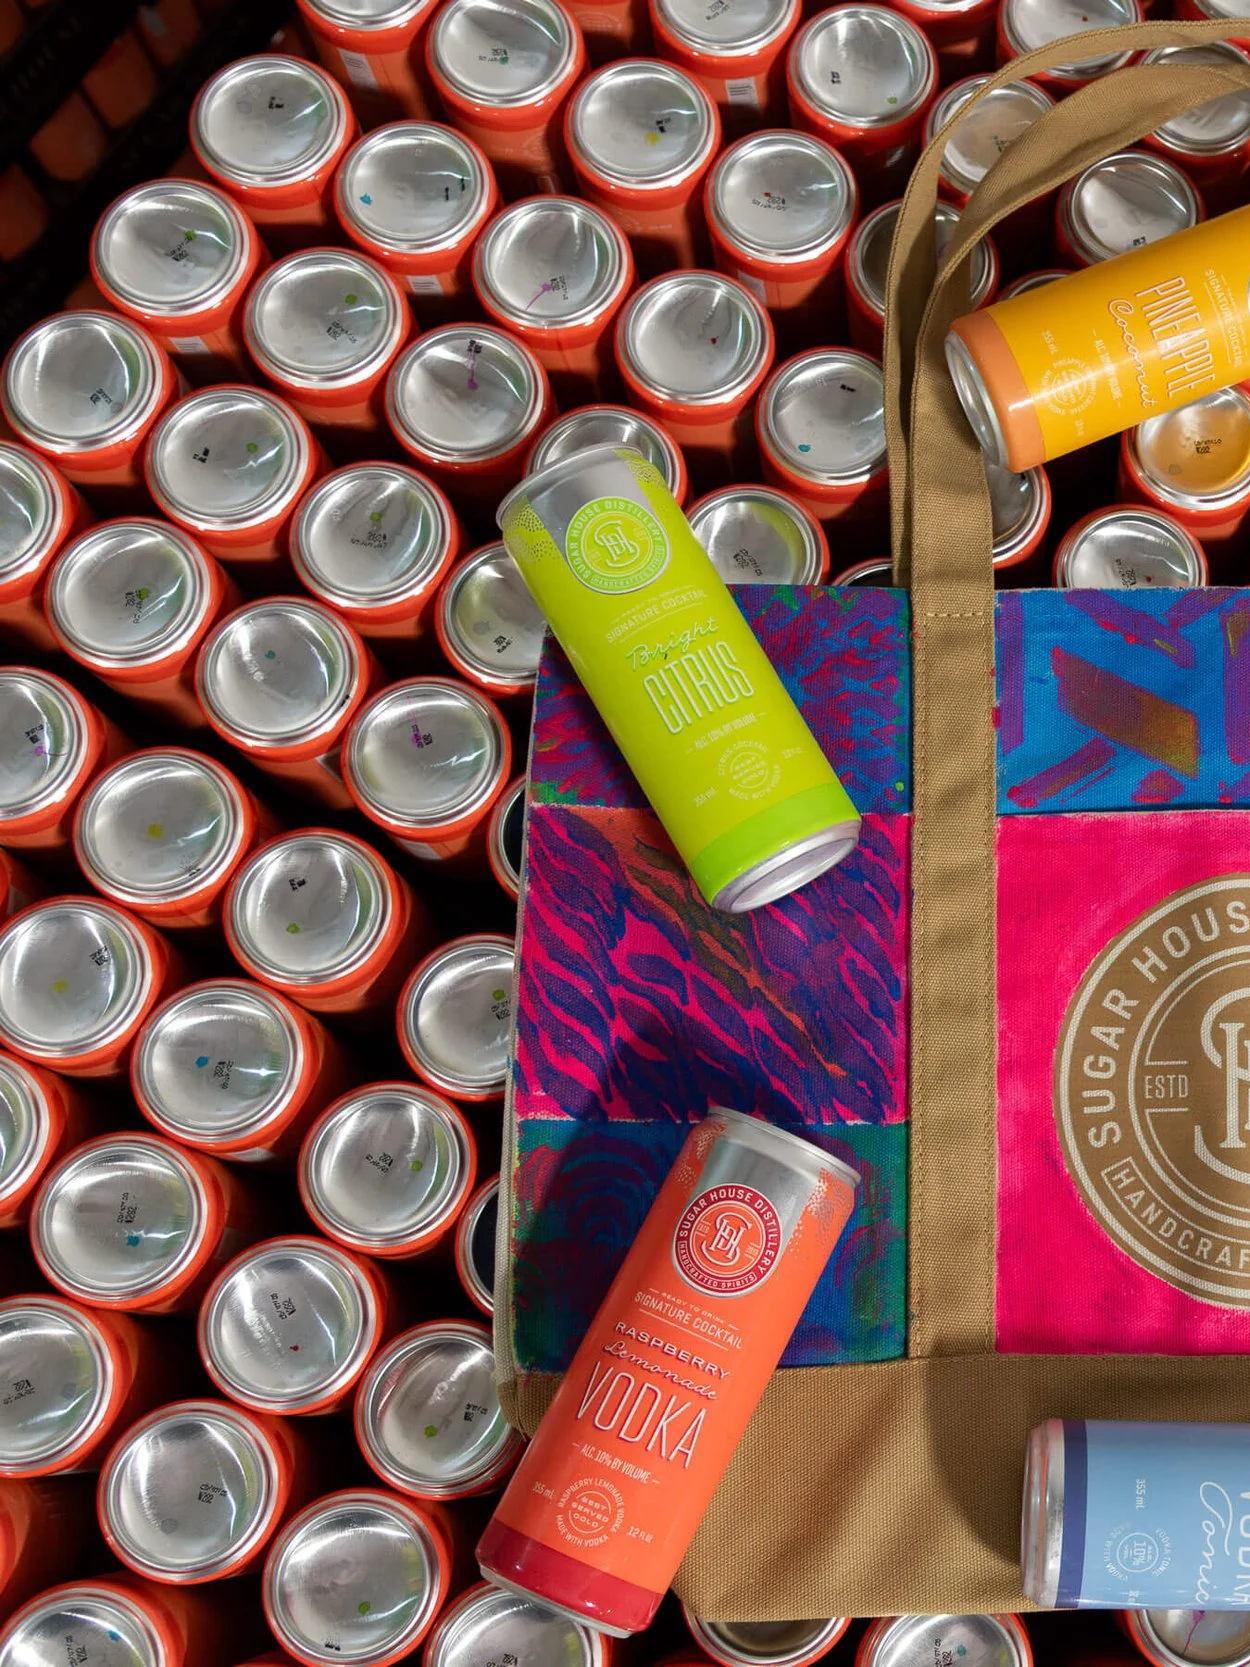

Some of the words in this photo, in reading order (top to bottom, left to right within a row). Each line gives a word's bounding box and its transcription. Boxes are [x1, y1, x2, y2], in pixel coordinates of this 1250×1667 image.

[1108, 299, 1156, 409] Coconut
[1135, 276, 1215, 399] PINEAPPLE
[571, 503, 601, 537] HOUSE
[605, 500, 662, 540] DISTILLERY
[570, 543, 592, 578] SUGAR
[606, 606, 660, 643] SIGNATURE
[626, 617, 718, 670] Bright
[644, 642, 754, 733] CITRUS
[1083, 987, 1140, 1149] SUGAR
[1144, 1077, 1189, 1099] ESTD
[680, 1198, 707, 1237] SUGAR
[710, 1188, 753, 1203] HOUSE
[754, 1200, 777, 1274] DISTILLERY
[680, 1243, 718, 1287] HANDCRAFTED
[721, 1274, 755, 1288] SPIRITS
[634, 1292, 694, 1325] SIGNATURE
[692, 1318, 744, 1350] COCKTAIL
[604, 1340, 717, 1400] Lemonade
[616, 1321, 730, 1380] RASPBERRY
[577, 1361, 707, 1469] VODKA
[595, 1449, 612, 1466] 10%
[611, 1457, 624, 1470] BY
[622, 1460, 651, 1484] VOLUME
[1136, 1479, 1146, 1494] 355
[558, 1477, 594, 1508] RASPBERRY
[594, 1477, 625, 1507] LEMONADE
[1133, 1541, 1147, 1566] 10%
[1152, 1557, 1172, 1577] TONIC
